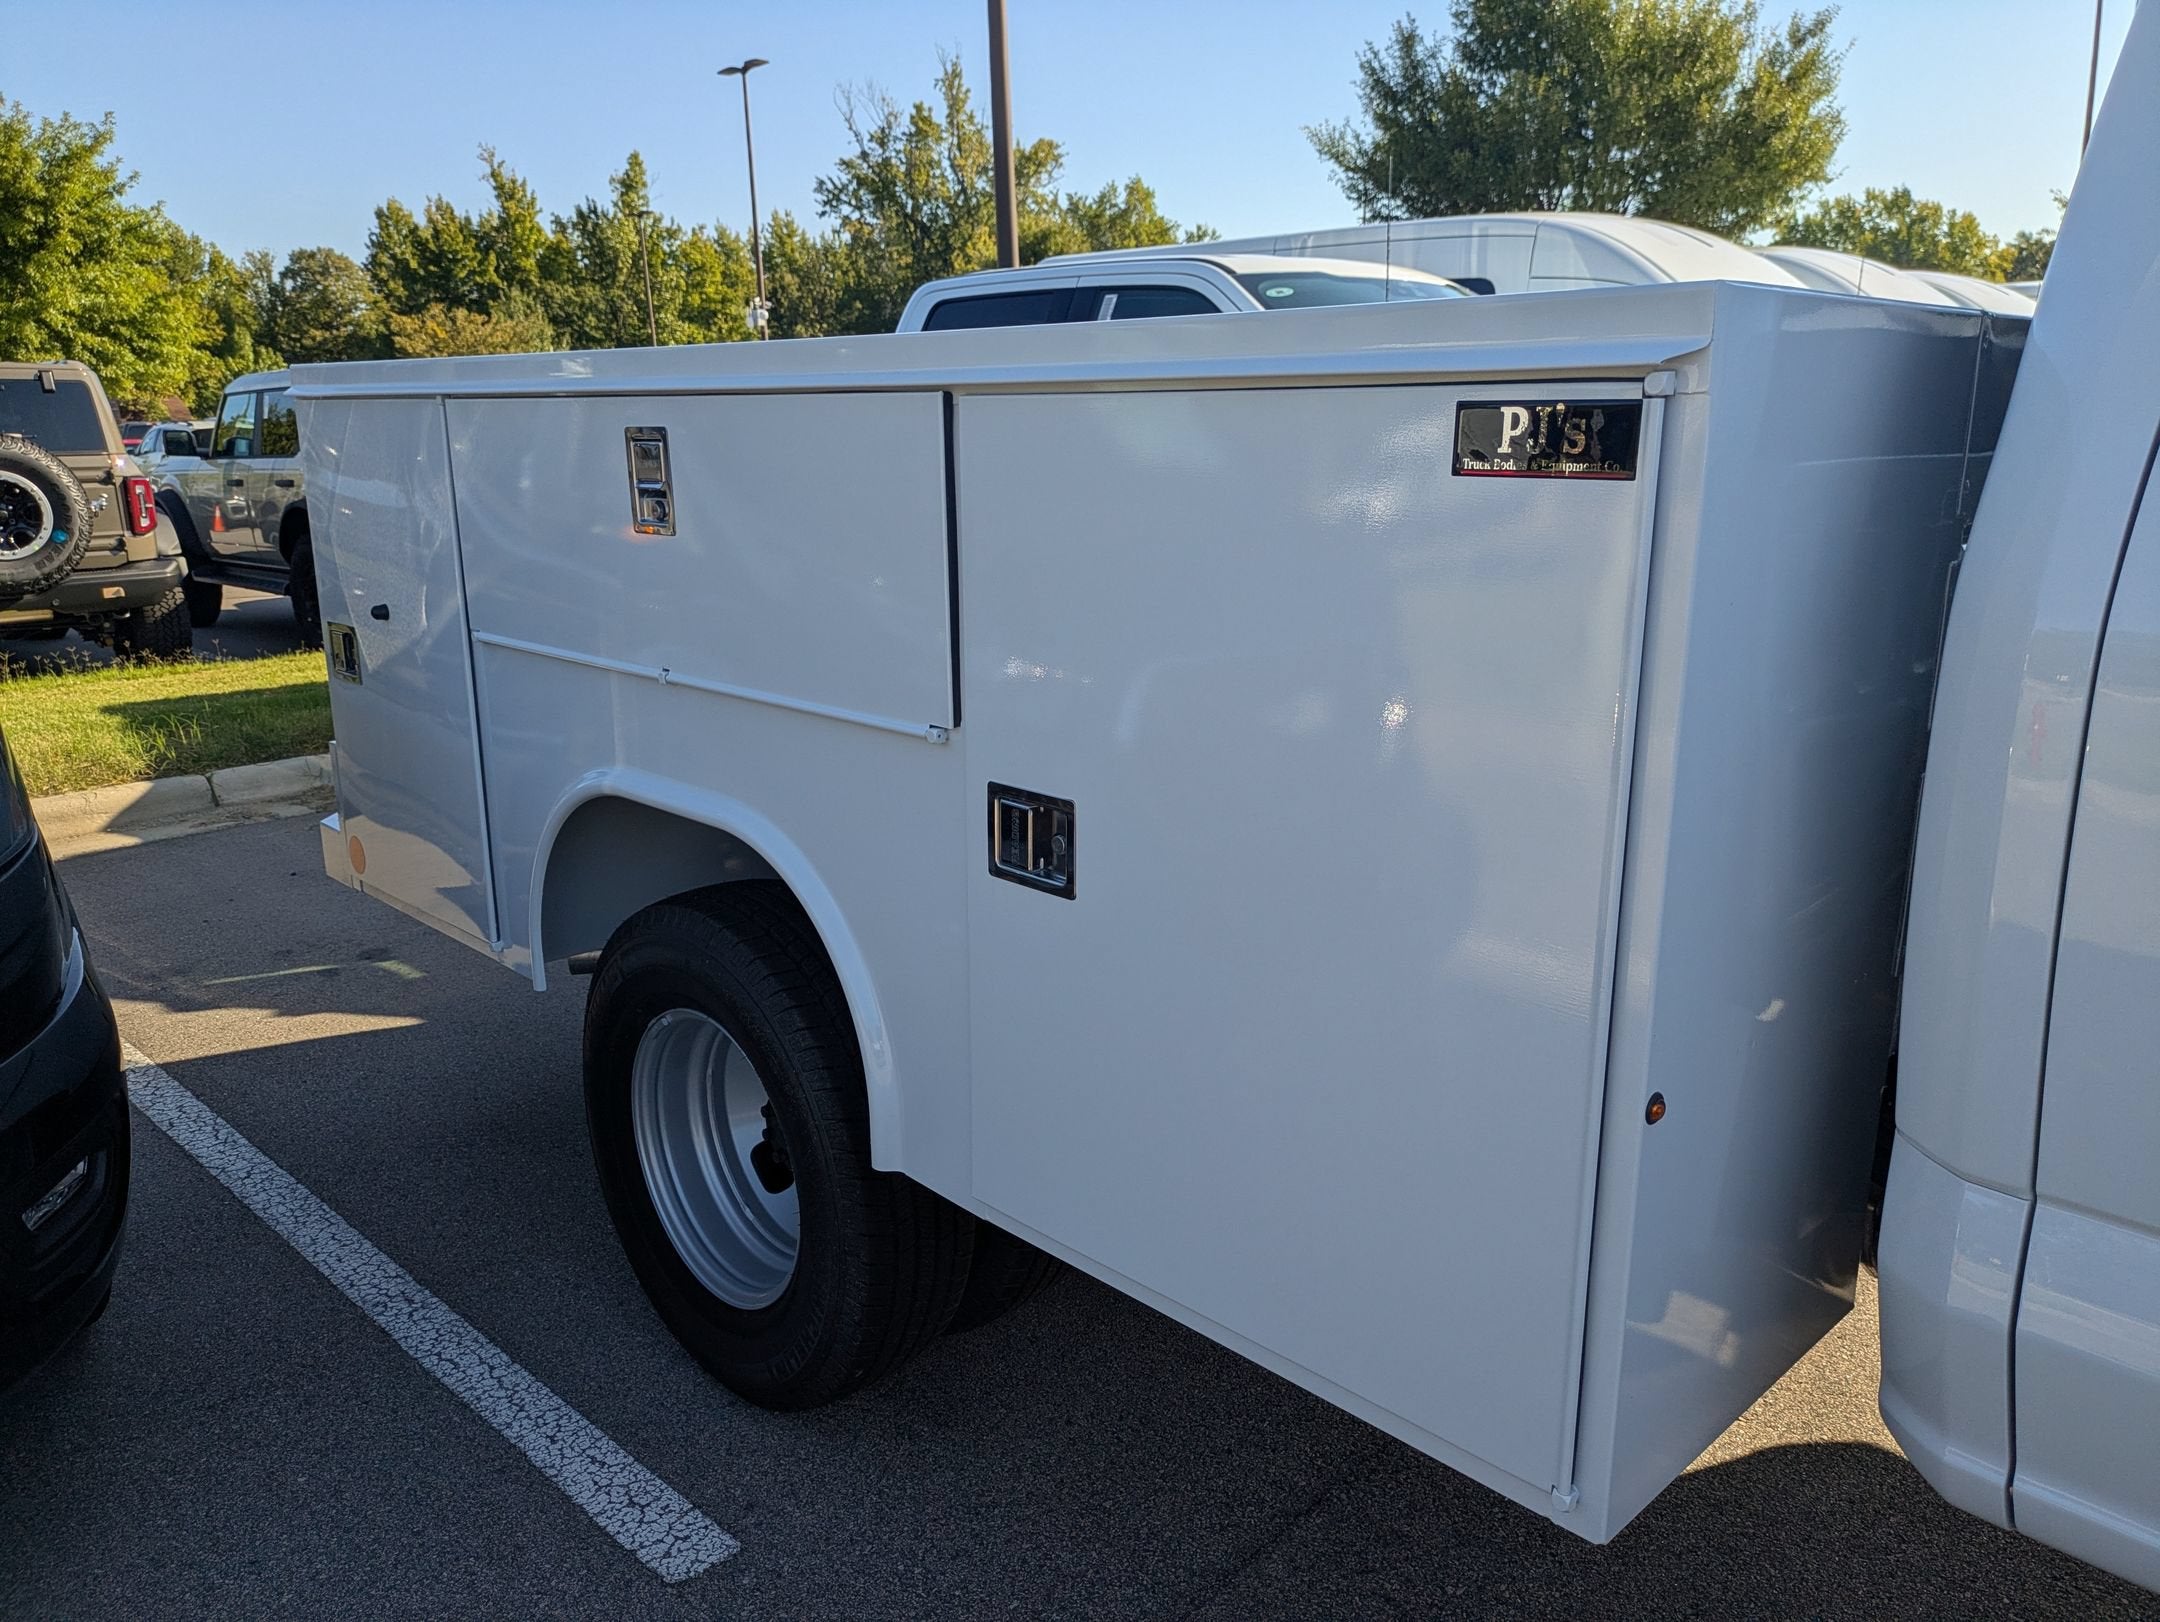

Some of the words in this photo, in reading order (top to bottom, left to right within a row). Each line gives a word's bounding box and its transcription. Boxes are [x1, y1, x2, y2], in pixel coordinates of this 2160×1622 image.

[1497, 403, 1586, 454] PJ's
[1463, 458, 1491, 470] Truck
[1541, 460, 1602, 475] Equipment
